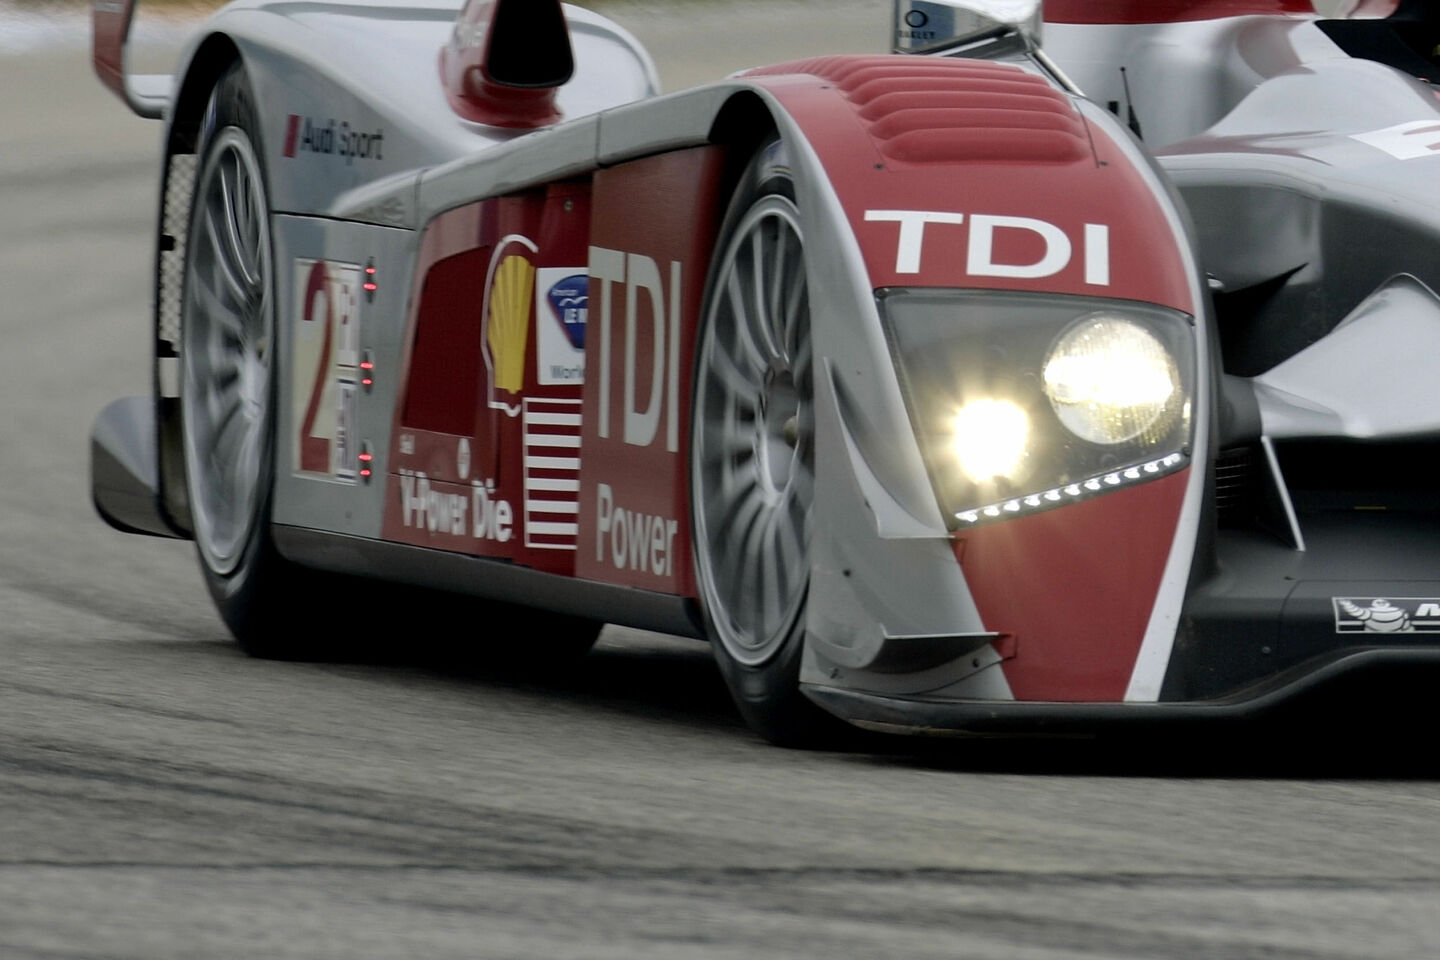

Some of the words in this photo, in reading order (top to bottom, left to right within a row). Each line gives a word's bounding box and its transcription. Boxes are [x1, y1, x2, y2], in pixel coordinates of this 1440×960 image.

[299, 117, 336, 155] Audi
[338, 121, 383, 166] Sport
[864, 209, 1110, 287] TDI
[299, 259, 333, 474] 2
[588, 245, 682, 454] TDI
[399, 468, 468, 536] V-Power
[471, 478, 514, 543] Die
[596, 483, 679, 577] Power
